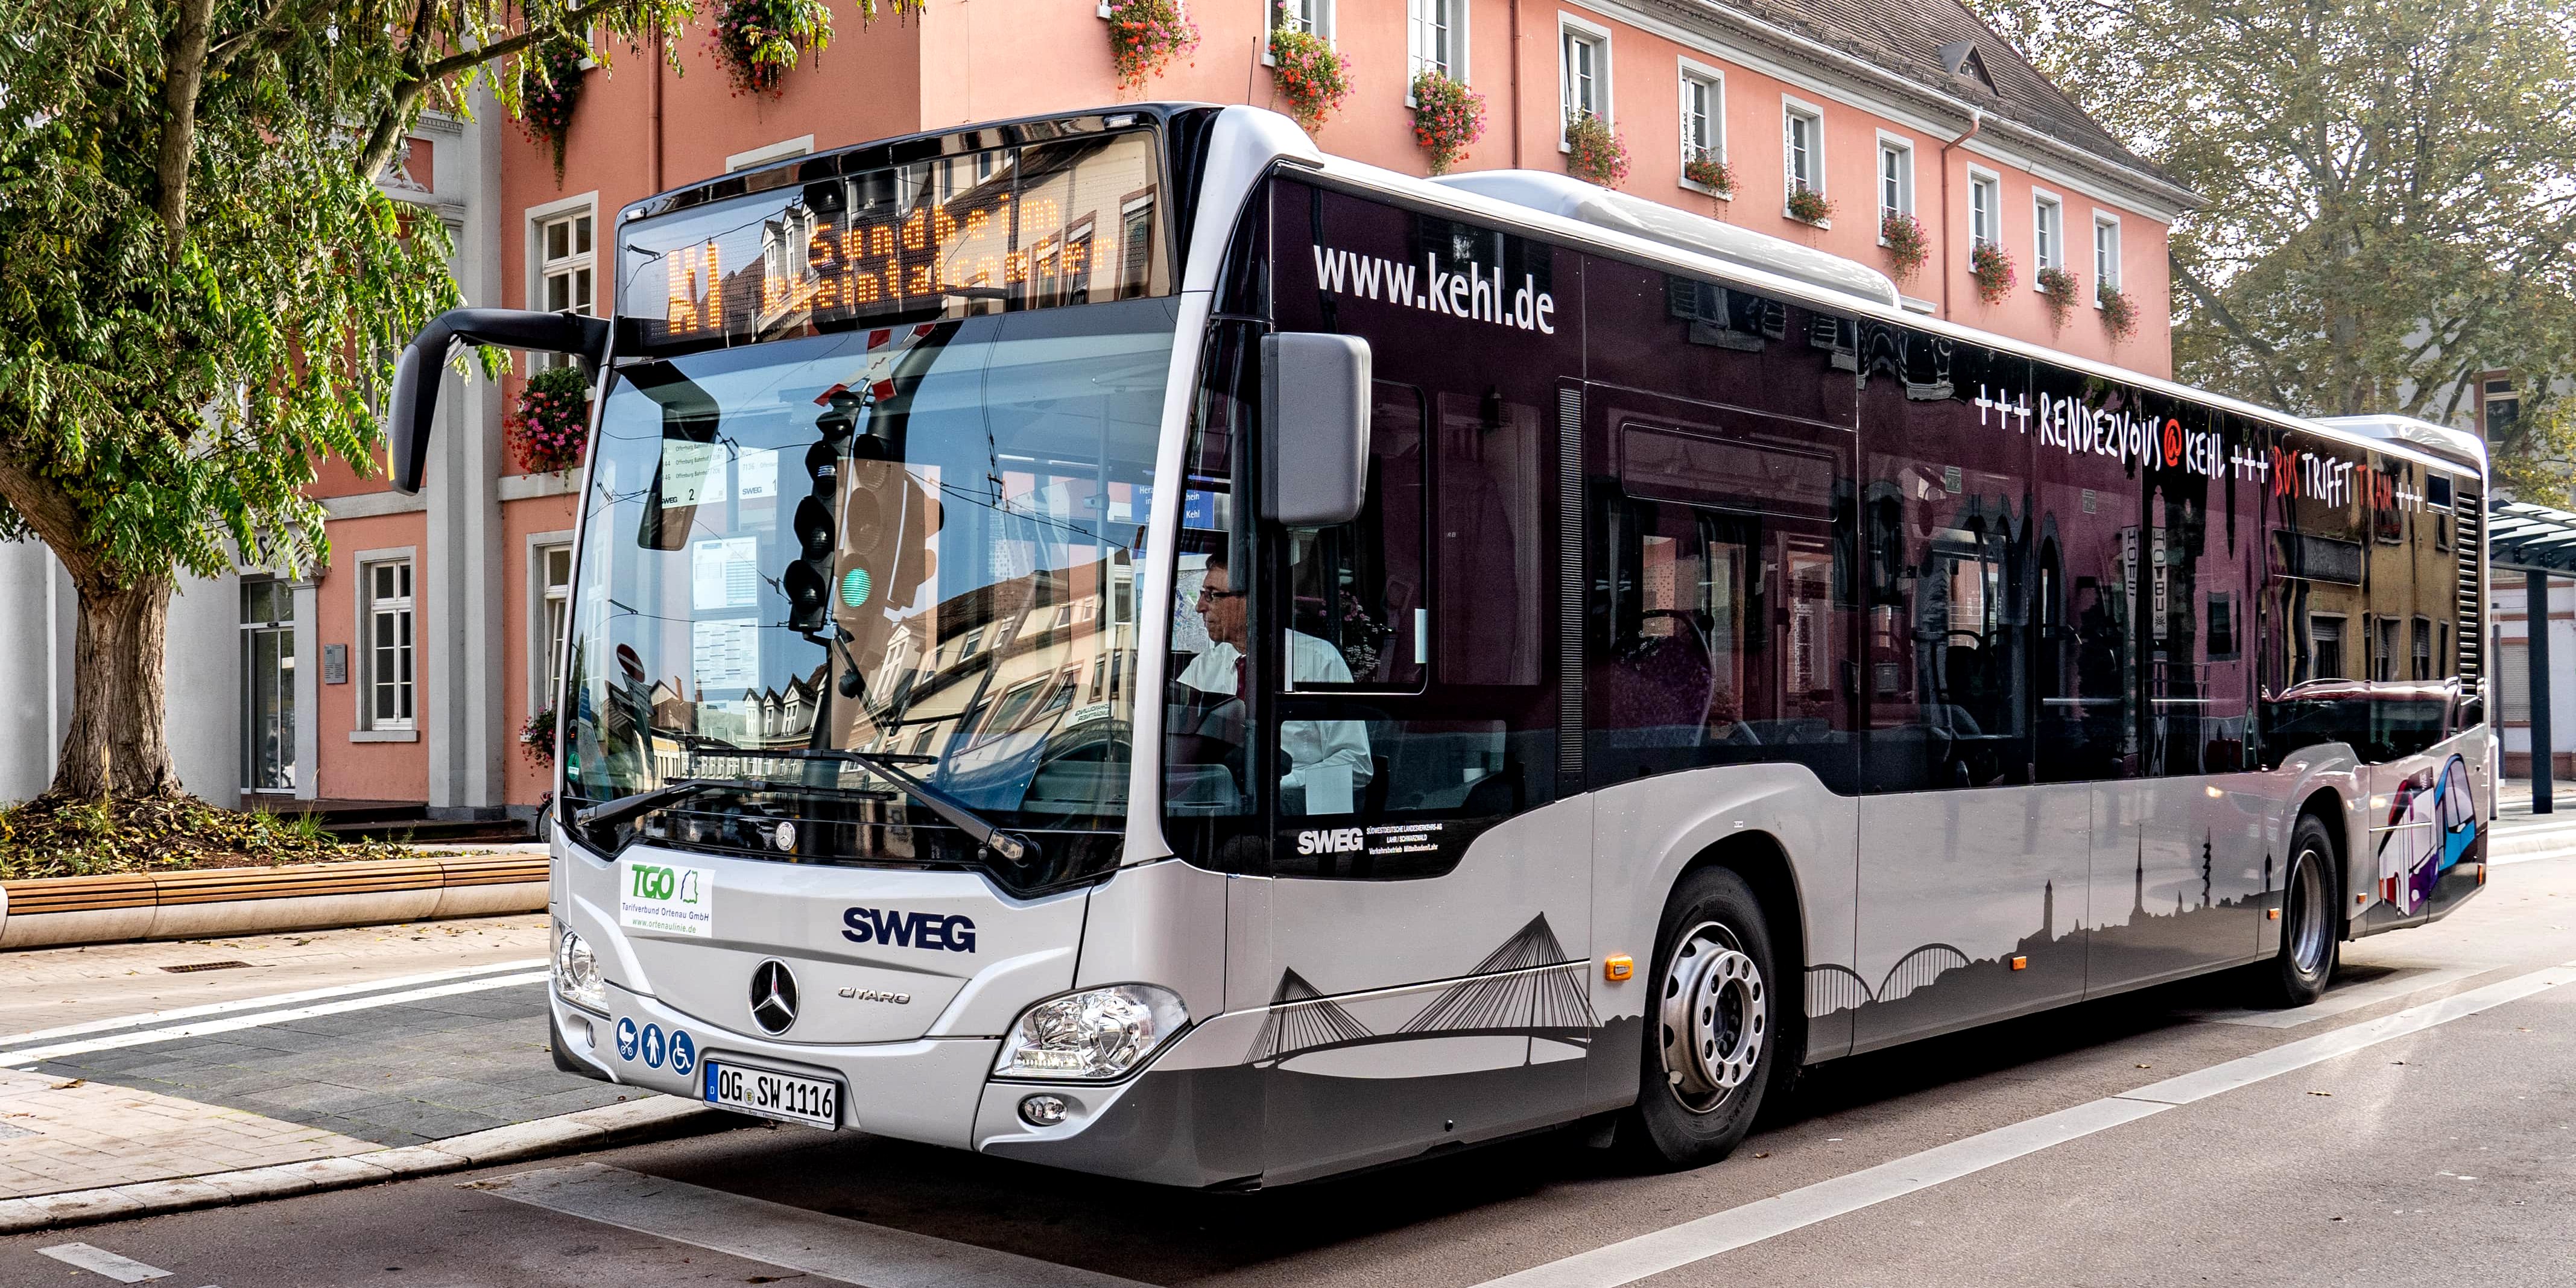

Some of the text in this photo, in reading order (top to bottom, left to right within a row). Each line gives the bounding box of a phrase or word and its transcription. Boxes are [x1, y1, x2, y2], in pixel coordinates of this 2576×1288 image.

[809, 193, 1059, 266] Sundheim
[1313, 244, 1554, 335] www.kehl.de
[742, 479, 777, 495] SWEG 1
[2274, 445, 2299, 499] BUS
[2302, 452, 2353, 509] TRIFFT
[2356, 464, 2392, 511] TRAM
[688, 488, 695, 501] 2
[1186, 492, 1200, 500] hein
[1186, 510, 1200, 519] Kehl
[1366, 825, 1404, 835] SÜDWESTDEUTSCHE
[1399, 834, 1428, 842] SCHWARZWALD
[1297, 827, 1364, 855] SWEG
[1369, 846, 1403, 855] Verkehrsbetrieb
[631, 863, 675, 901] TGO
[622, 902, 709, 921] Tarifverbund Ortenau GmbH
[632, 918, 697, 933] www.ortenaulinie.de
[841, 906, 976, 954] SWEG
[838, 986, 911, 1005] CITARO
[709, 1069, 833, 1119] D OG SW 1116
